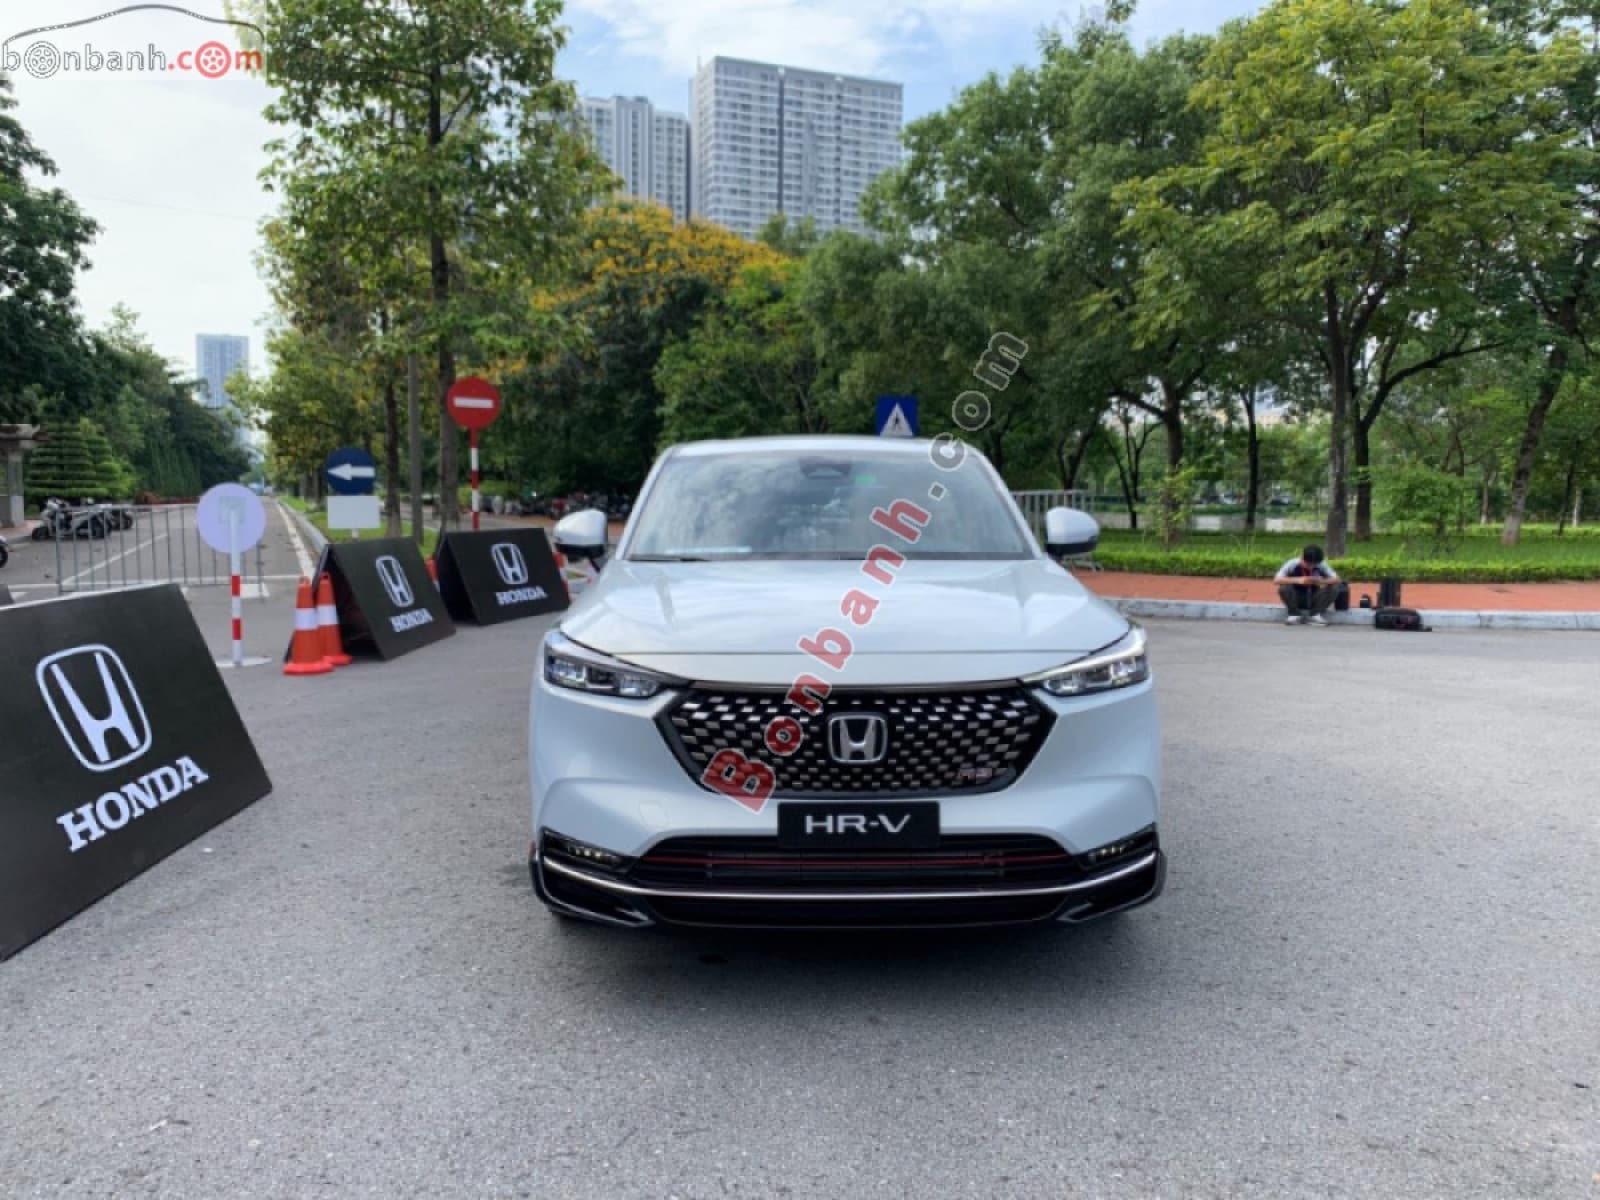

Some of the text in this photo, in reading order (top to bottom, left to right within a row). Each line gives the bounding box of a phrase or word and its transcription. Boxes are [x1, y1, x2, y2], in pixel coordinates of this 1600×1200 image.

[495, 586, 547, 606] HONDA
[56, 755, 209, 852] HONDA
[804, 813, 911, 834] HR-V
